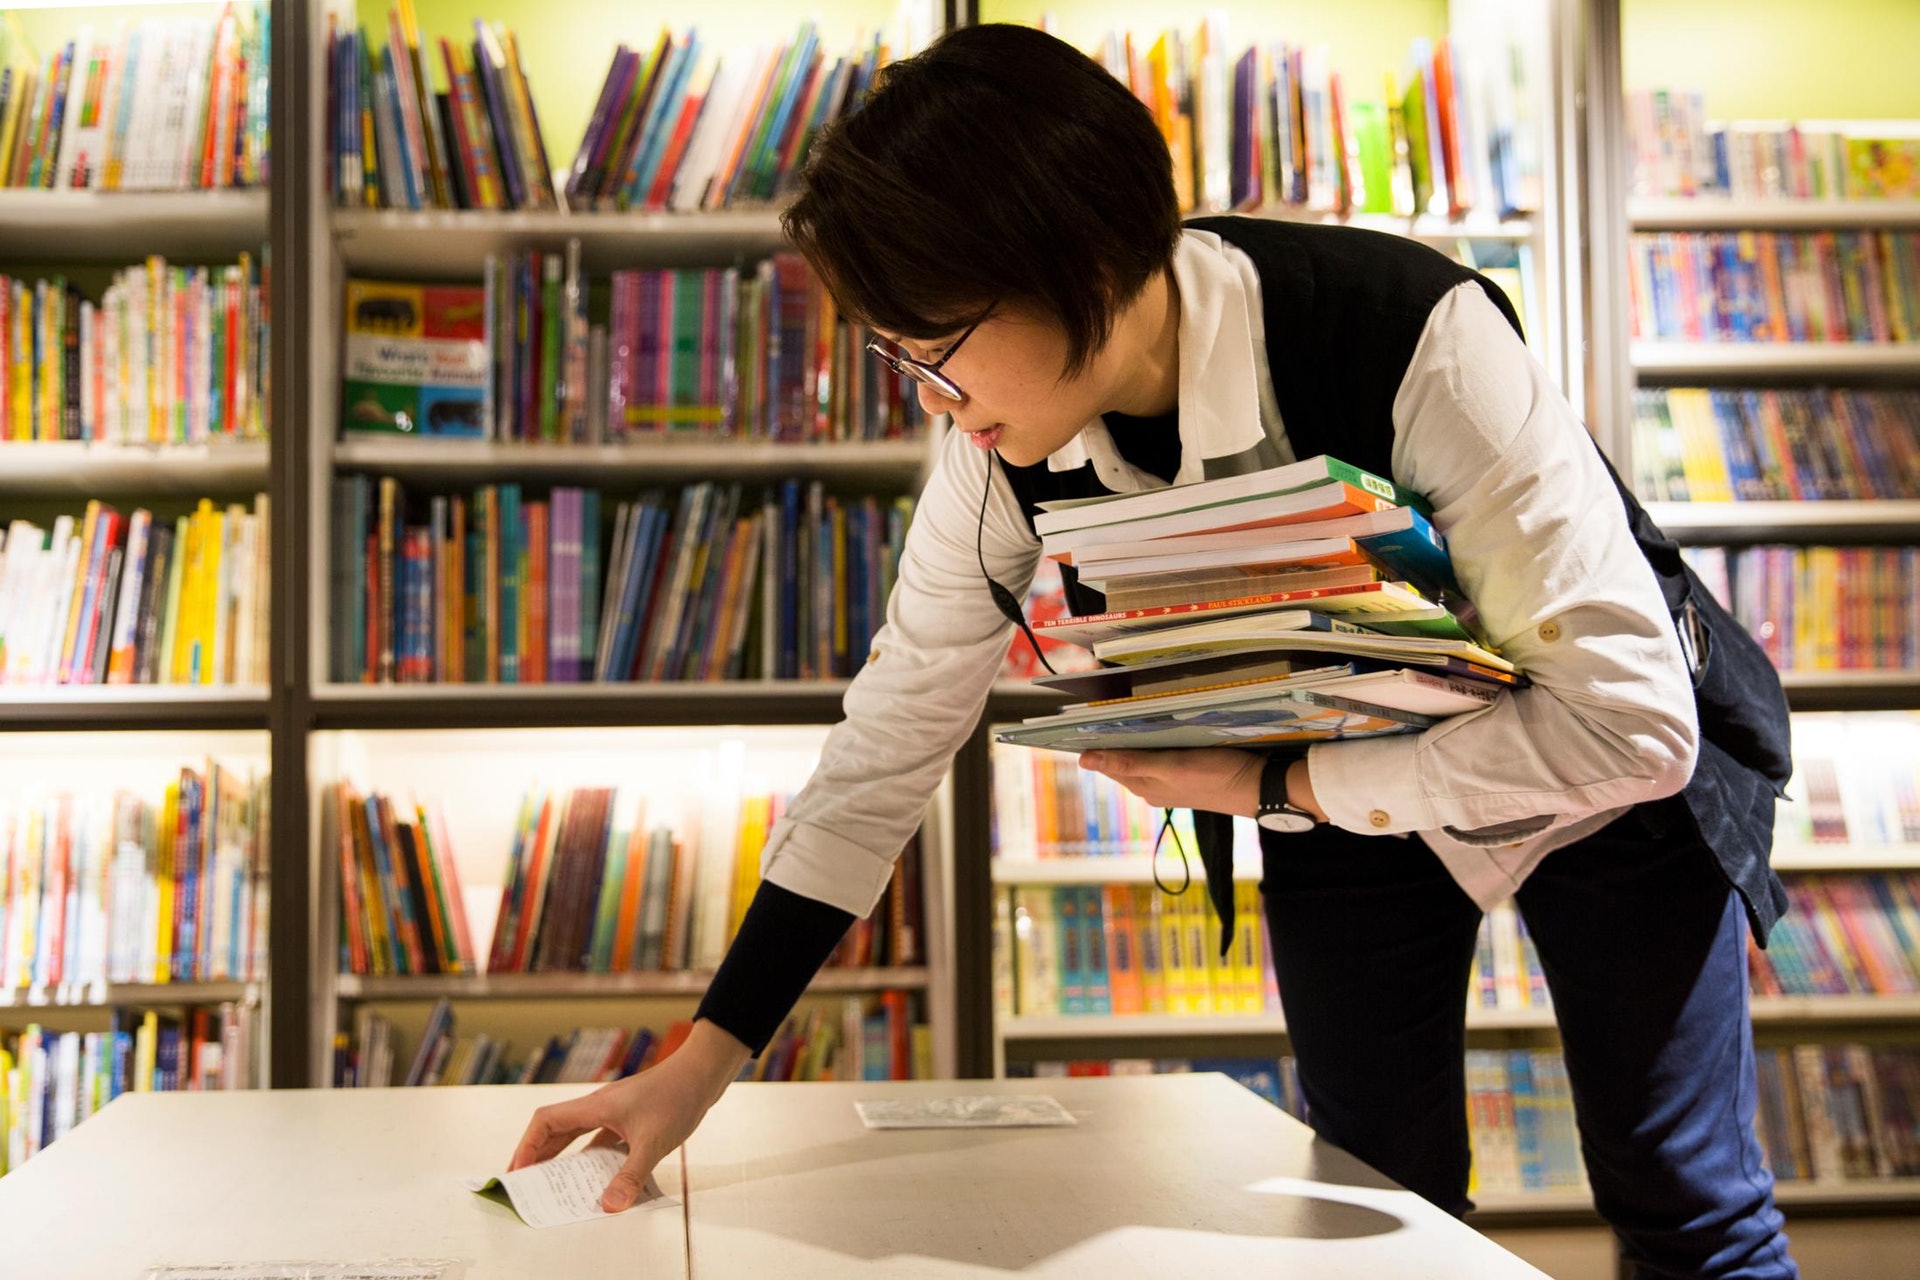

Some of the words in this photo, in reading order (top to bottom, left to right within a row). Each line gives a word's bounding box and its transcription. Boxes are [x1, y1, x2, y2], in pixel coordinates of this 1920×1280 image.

[1043, 619, 1057, 627] TEN
[1057, 616, 1088, 626] TERRIBLE
[1089, 612, 1127, 622] DINOSAURS
[1208, 600, 1227, 609] PAUL
[1227, 596, 1272, 607] STICKLAND
